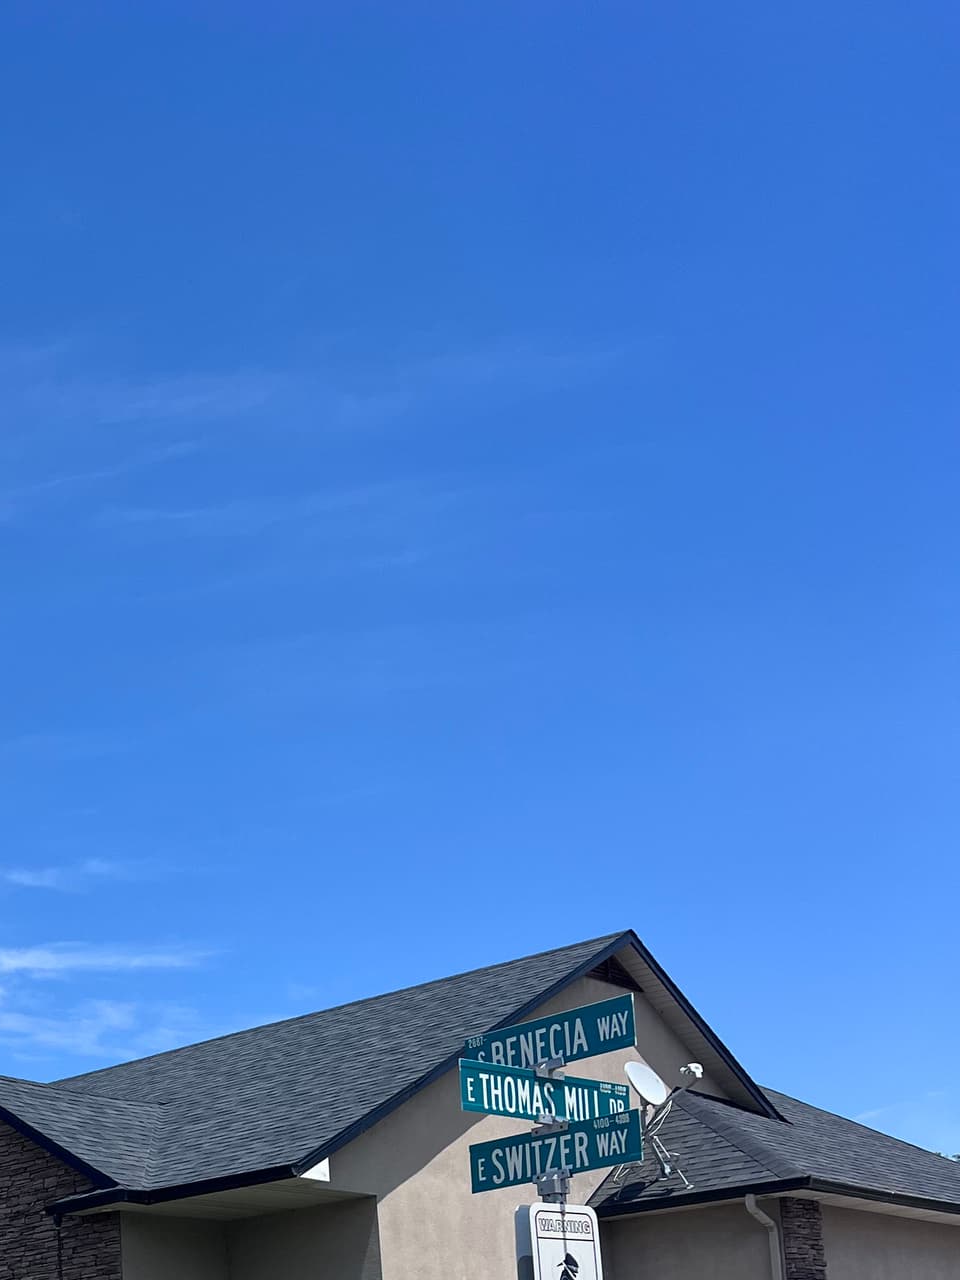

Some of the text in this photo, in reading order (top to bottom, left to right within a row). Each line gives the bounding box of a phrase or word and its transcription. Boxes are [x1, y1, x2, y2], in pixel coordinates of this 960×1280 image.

[491, 1018, 589, 1068] BENECIA
[597, 1010, 629, 1042] WAY
[466, 1077, 476, 1103] E
[478, 1072, 556, 1117] THOMAS
[477, 1129, 629, 1184] E SWITZER WAY
[538, 1217, 592, 1235] WARNING
